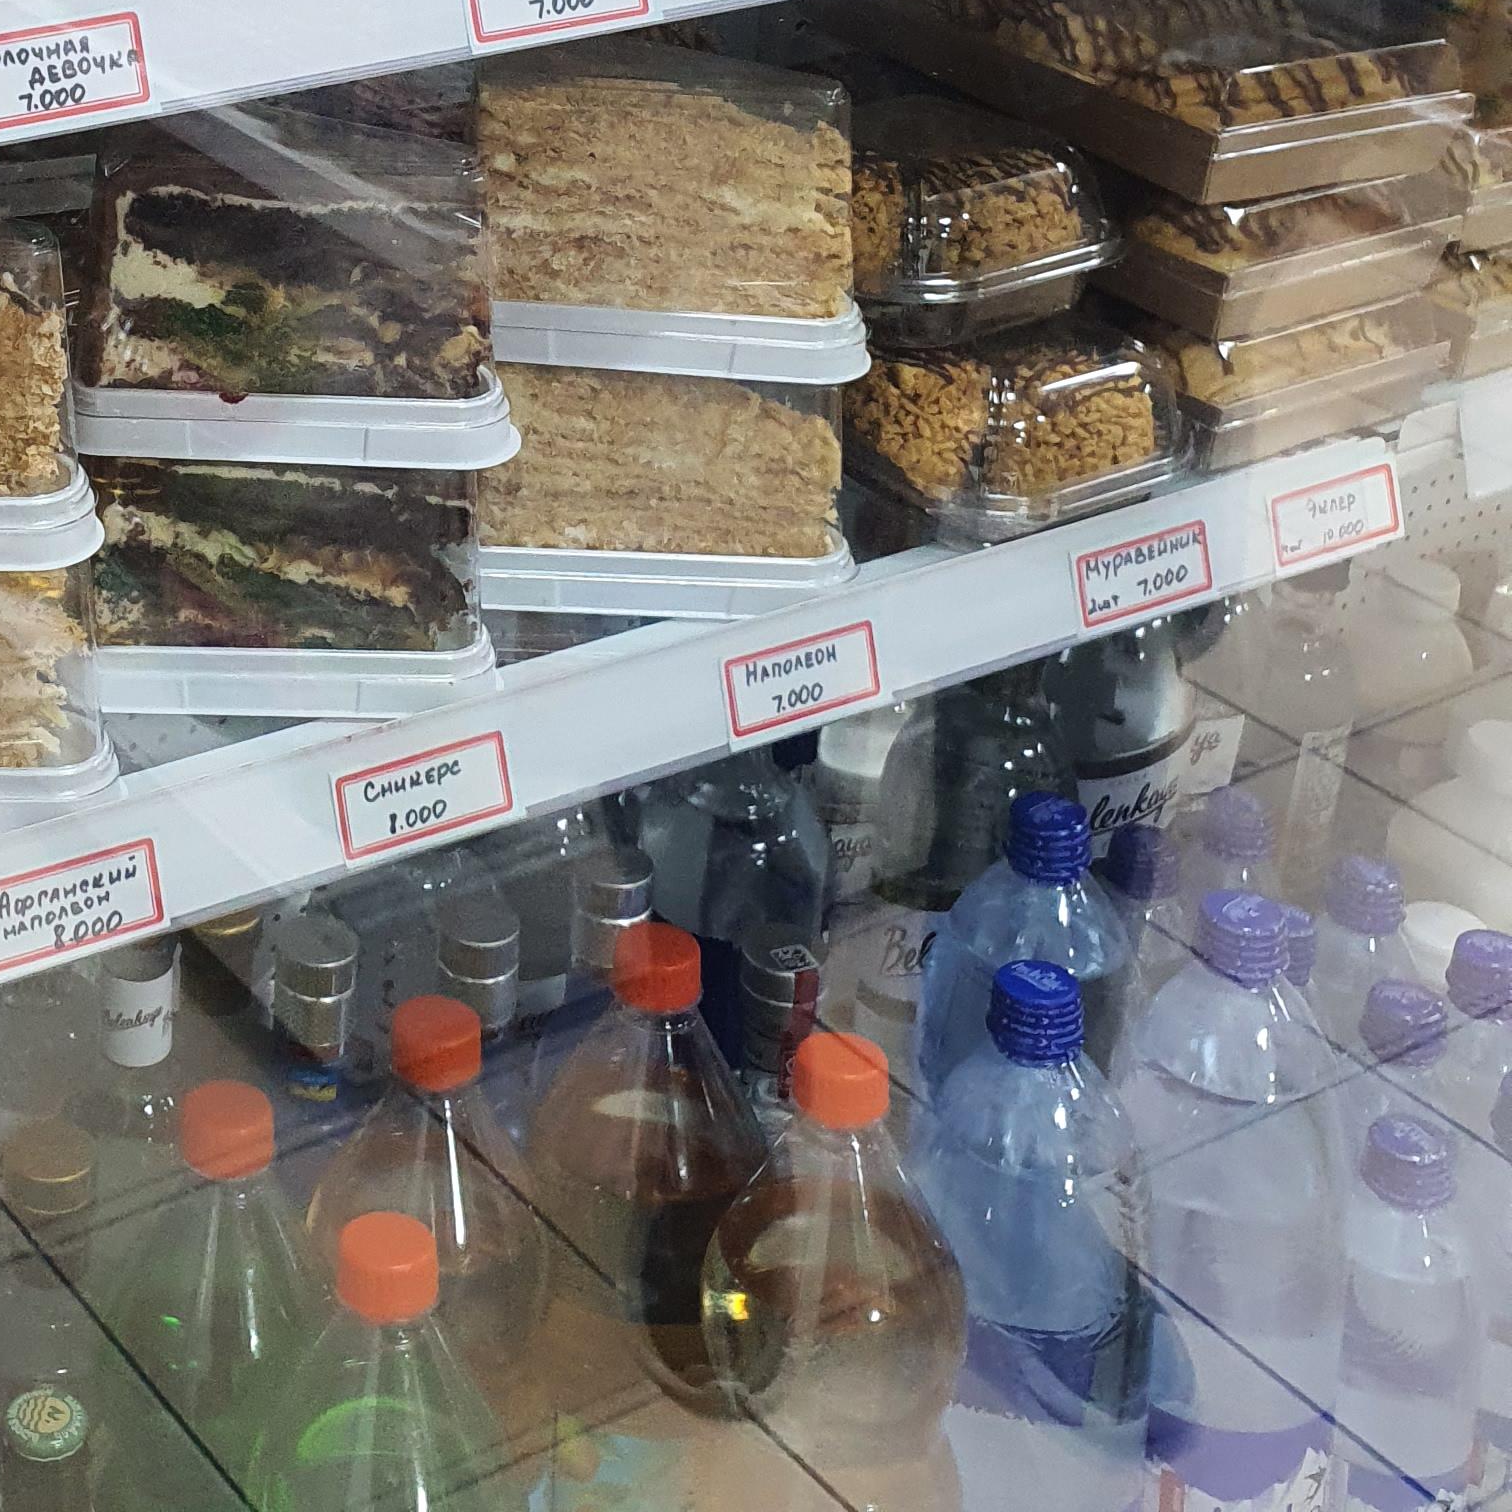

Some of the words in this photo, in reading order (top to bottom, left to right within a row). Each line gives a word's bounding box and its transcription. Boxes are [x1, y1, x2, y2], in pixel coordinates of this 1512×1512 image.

[18, 83, 86, 112] 7.000
[1136, 564, 1188, 597] 7.000
[771, 682, 824, 713] 7.000
[54, 910, 123, 950] 8.000
